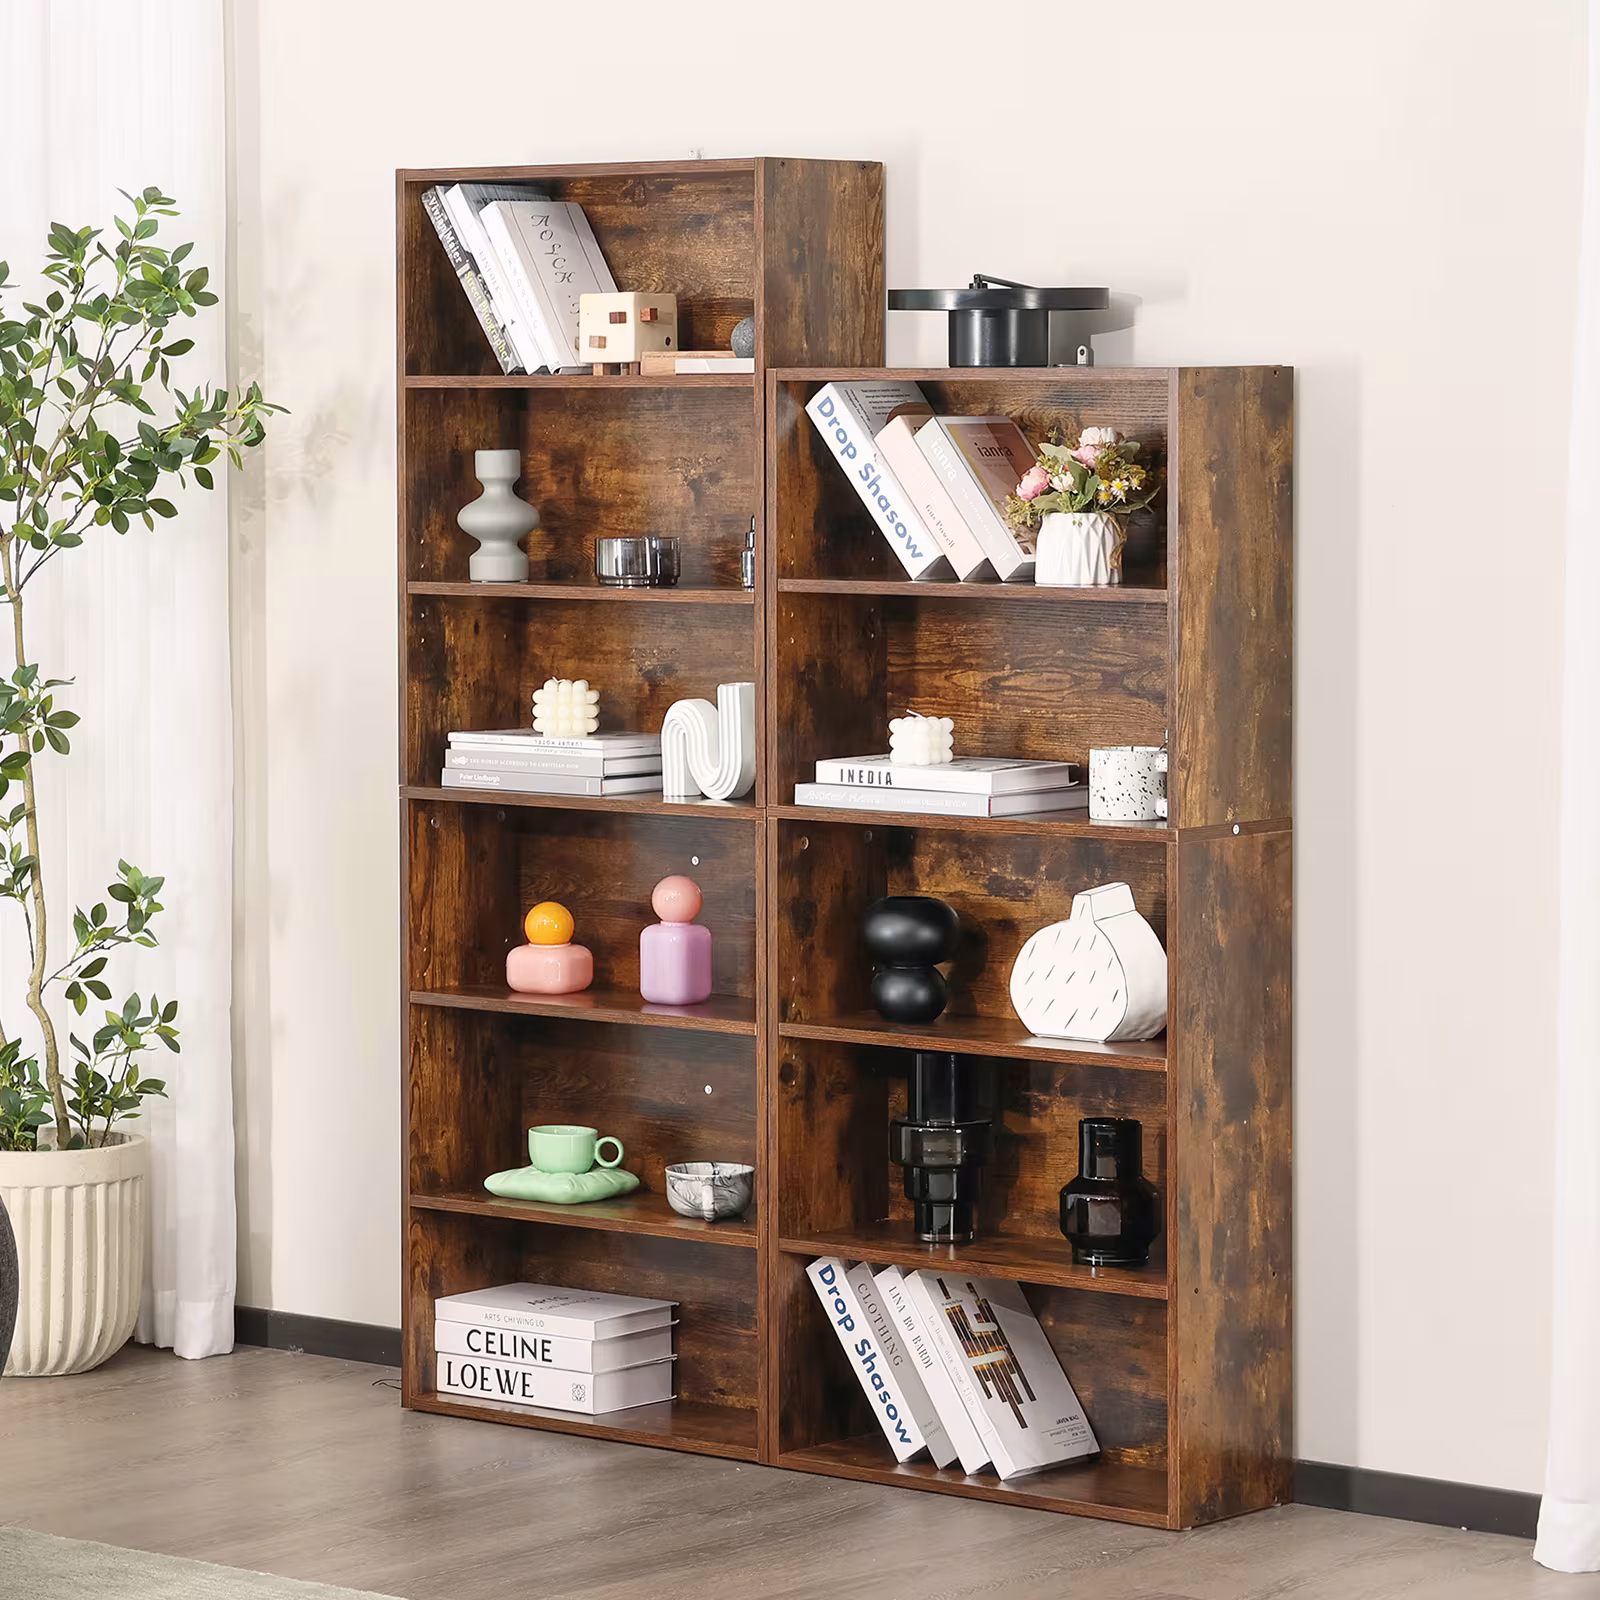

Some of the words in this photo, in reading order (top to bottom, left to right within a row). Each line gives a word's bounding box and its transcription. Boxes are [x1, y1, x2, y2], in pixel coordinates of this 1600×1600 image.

[427, 194, 453, 236] Vivian
[443, 226, 463, 264] Maier
[463, 270, 482, 301] Street
[817, 396, 857, 460] Drop
[858, 463, 924, 560] Shasow
[840, 768, 893, 786] INEDIA
[466, 1328, 553, 1363] CELINE
[484, 1312, 501, 1322] ARTS
[504, 1315, 516, 1324] CHI
[516, 1316, 535, 1327] WING
[535, 1319, 545, 1328] LO
[857, 1282, 904, 1368] CLOTHING
[888, 1284, 904, 1315] LINA
[903, 1315, 917, 1334] BO
[912, 1334, 934, 1370] BARDI
[446, 1360, 535, 1399] LOEWE
[818, 1263, 856, 1334] Drop
[855, 1338, 912, 1444] Shasow
